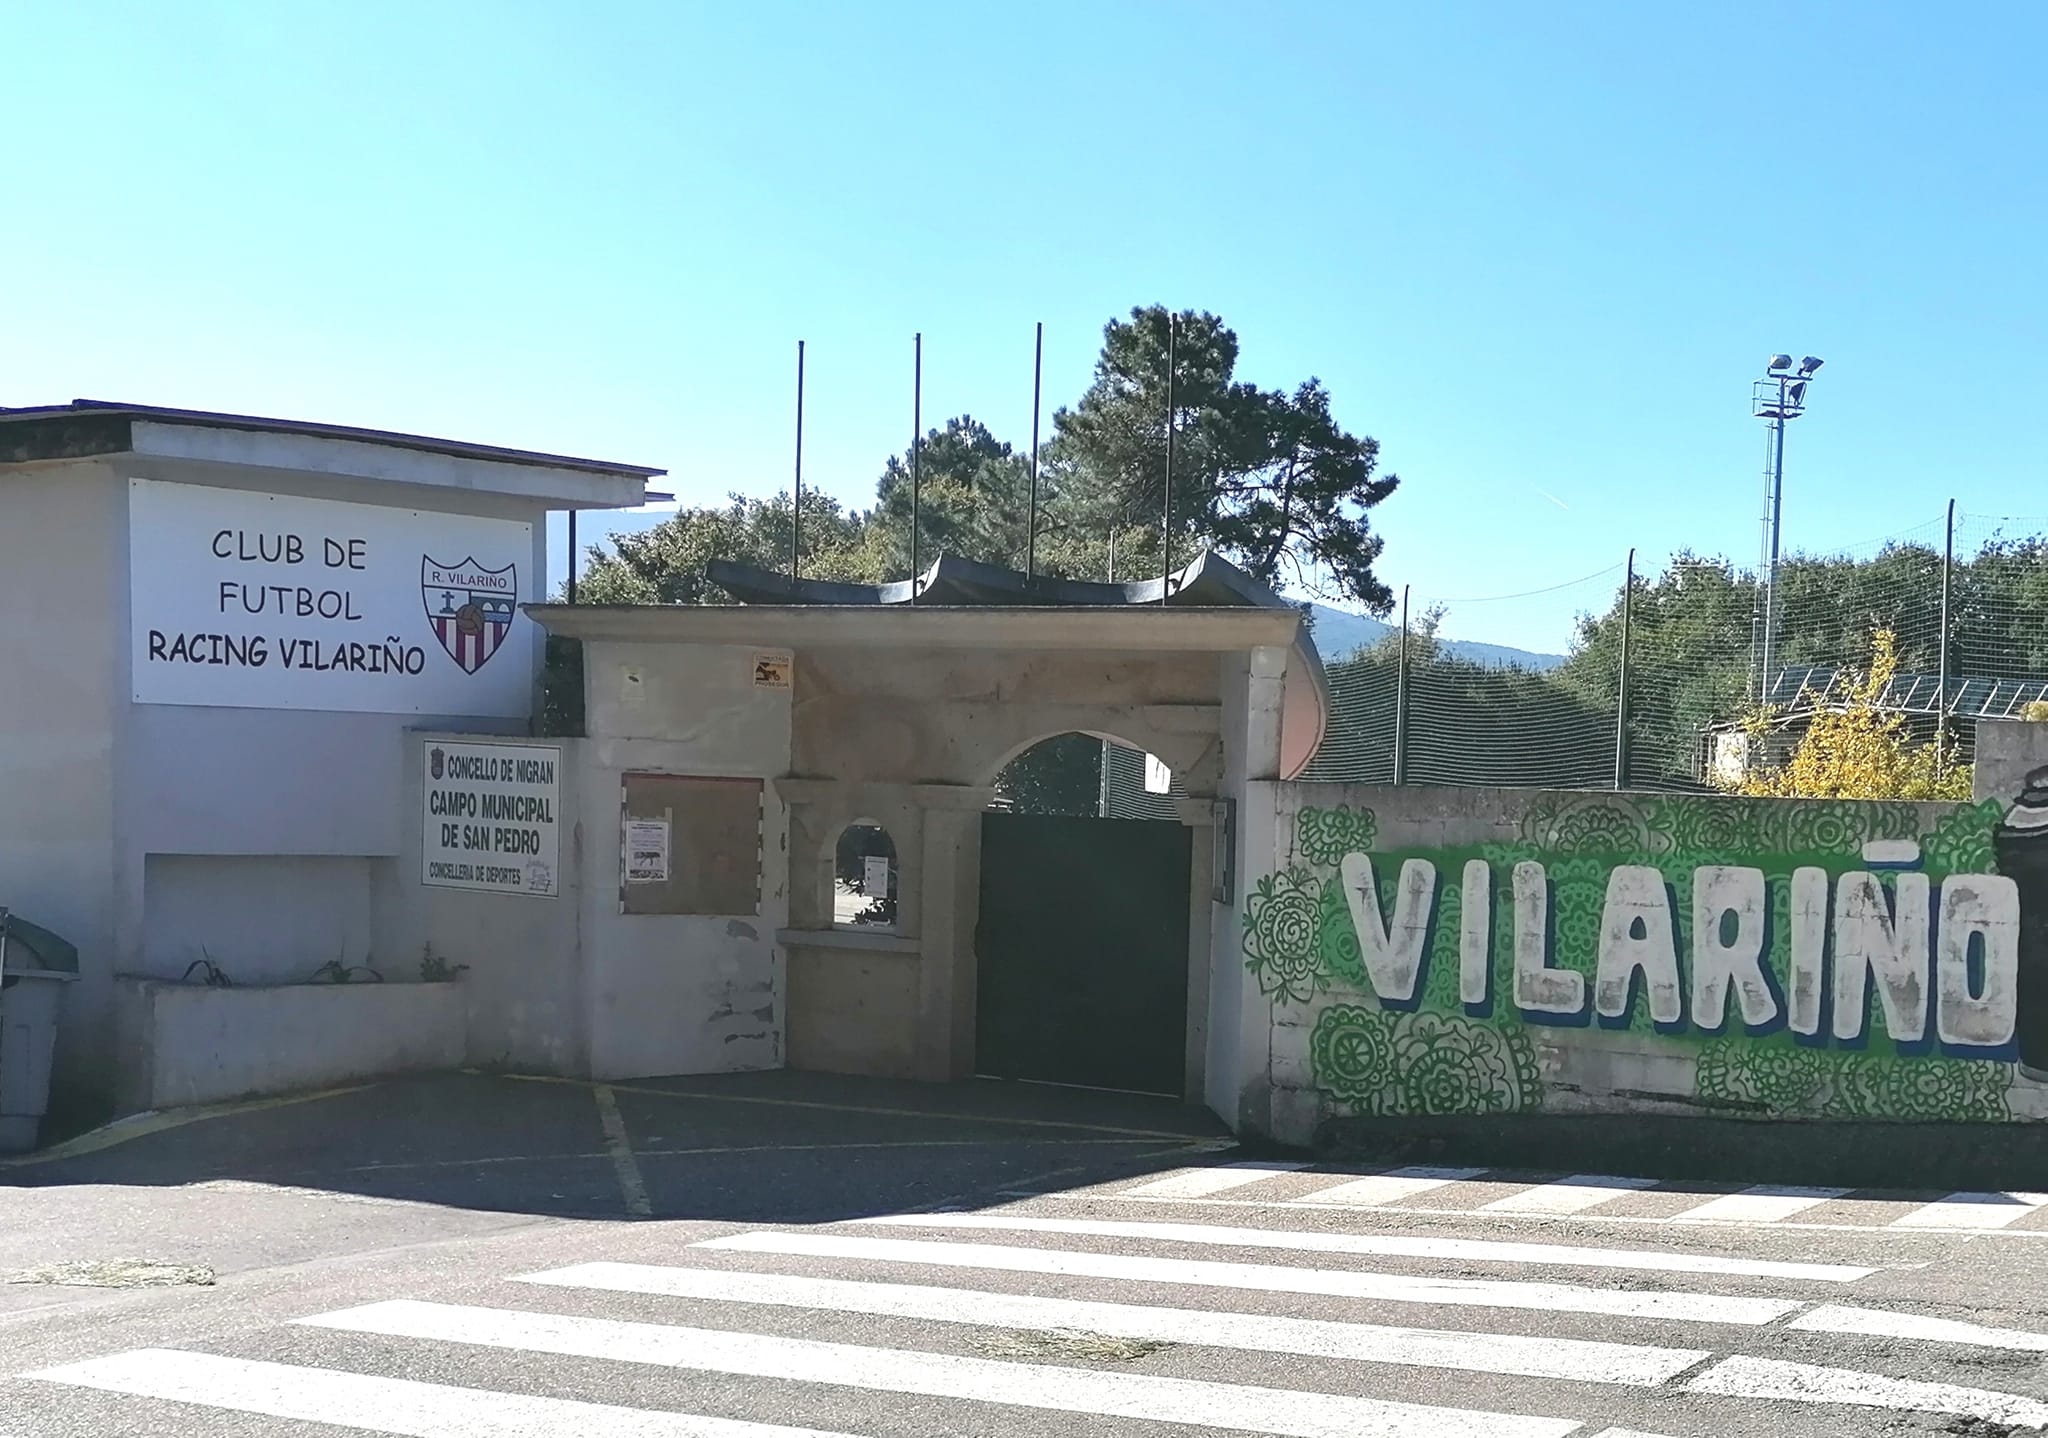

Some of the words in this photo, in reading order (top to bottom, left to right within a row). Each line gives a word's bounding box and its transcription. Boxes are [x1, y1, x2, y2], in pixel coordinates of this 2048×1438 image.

[212, 530, 304, 564] CLUB
[324, 538, 367, 570] DE
[432, 570, 445, 584] R.
[448, 573, 508, 588] VILARIÑO
[220, 582, 362, 621] FUTBOL
[148, 630, 268, 667] RACING
[279, 637, 426, 675] VILARIÑO
[448, 755, 497, 781] CONCELLO
[501, 759, 513, 782] DE
[516, 759, 553, 784] NIGRAN
[430, 790, 477, 818] CAMPO
[481, 793, 553, 823] MUNICIPAL
[441, 823, 459, 848] DE
[463, 824, 489, 851] SAN
[494, 828, 540, 855] PEDRO
[429, 861, 473, 880] CONCELLERIA
[475, 865, 484, 882] DE
[486, 867, 520, 885] DEPORTES
[1340, 838, 2022, 1048] VILARIÑO
